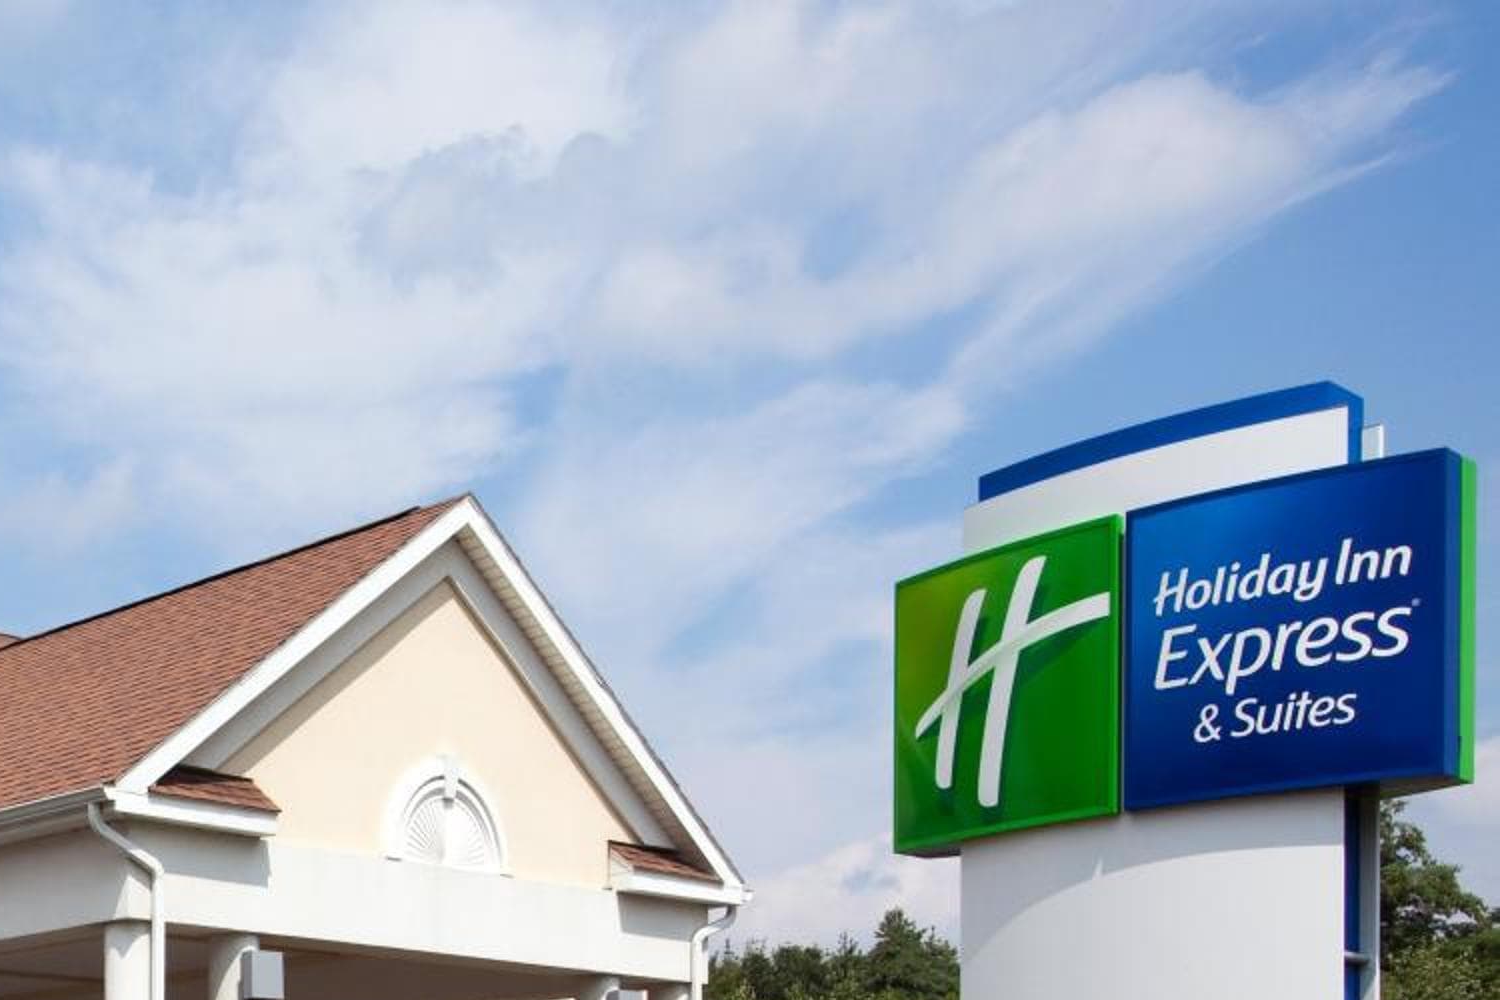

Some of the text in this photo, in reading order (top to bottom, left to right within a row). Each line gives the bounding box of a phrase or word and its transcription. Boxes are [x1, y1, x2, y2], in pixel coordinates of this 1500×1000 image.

[1153, 537, 1412, 617] Holiday Inn
[1153, 603, 1413, 696] Express
[1193, 690, 1358, 743] & Suites
